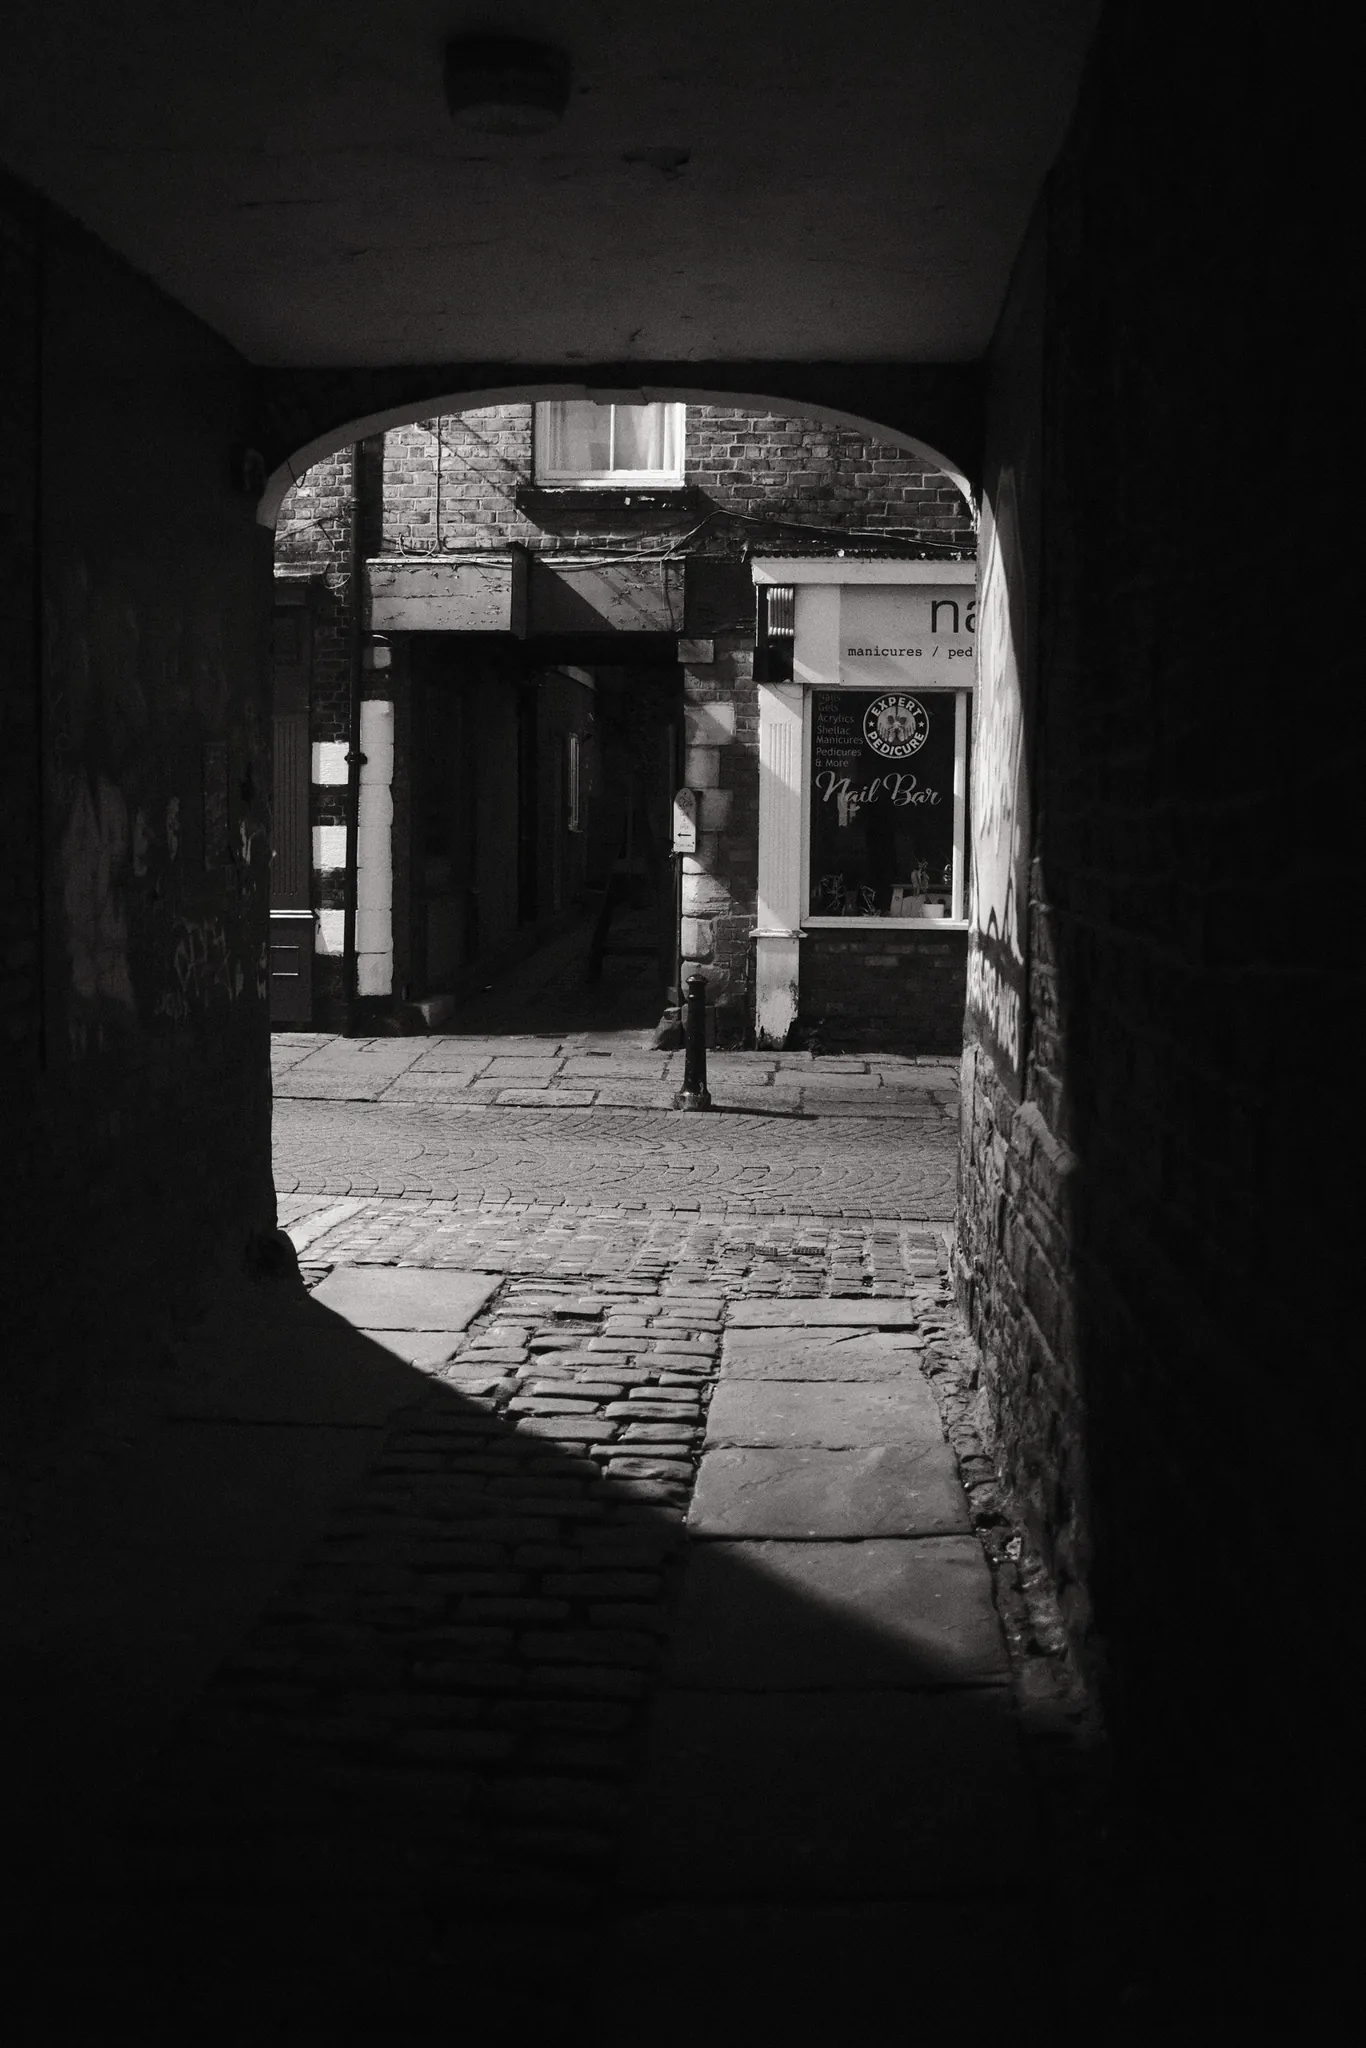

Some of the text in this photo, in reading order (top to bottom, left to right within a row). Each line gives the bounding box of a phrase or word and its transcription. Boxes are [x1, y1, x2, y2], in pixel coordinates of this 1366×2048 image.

[848, 646, 922, 657] manicures
[948, 647, 973, 659] ped
[871, 696, 922, 717] EXPERT
[817, 713, 855, 724] Acrylics
[816, 726, 851, 735] Shellac
[816, 735, 863, 744] Manicures
[868, 731, 925, 756] PEDICURE
[816, 747, 862, 757] Pedicures
[825, 759, 849, 767] More
[815, 770, 942, 812] Nail Bar
